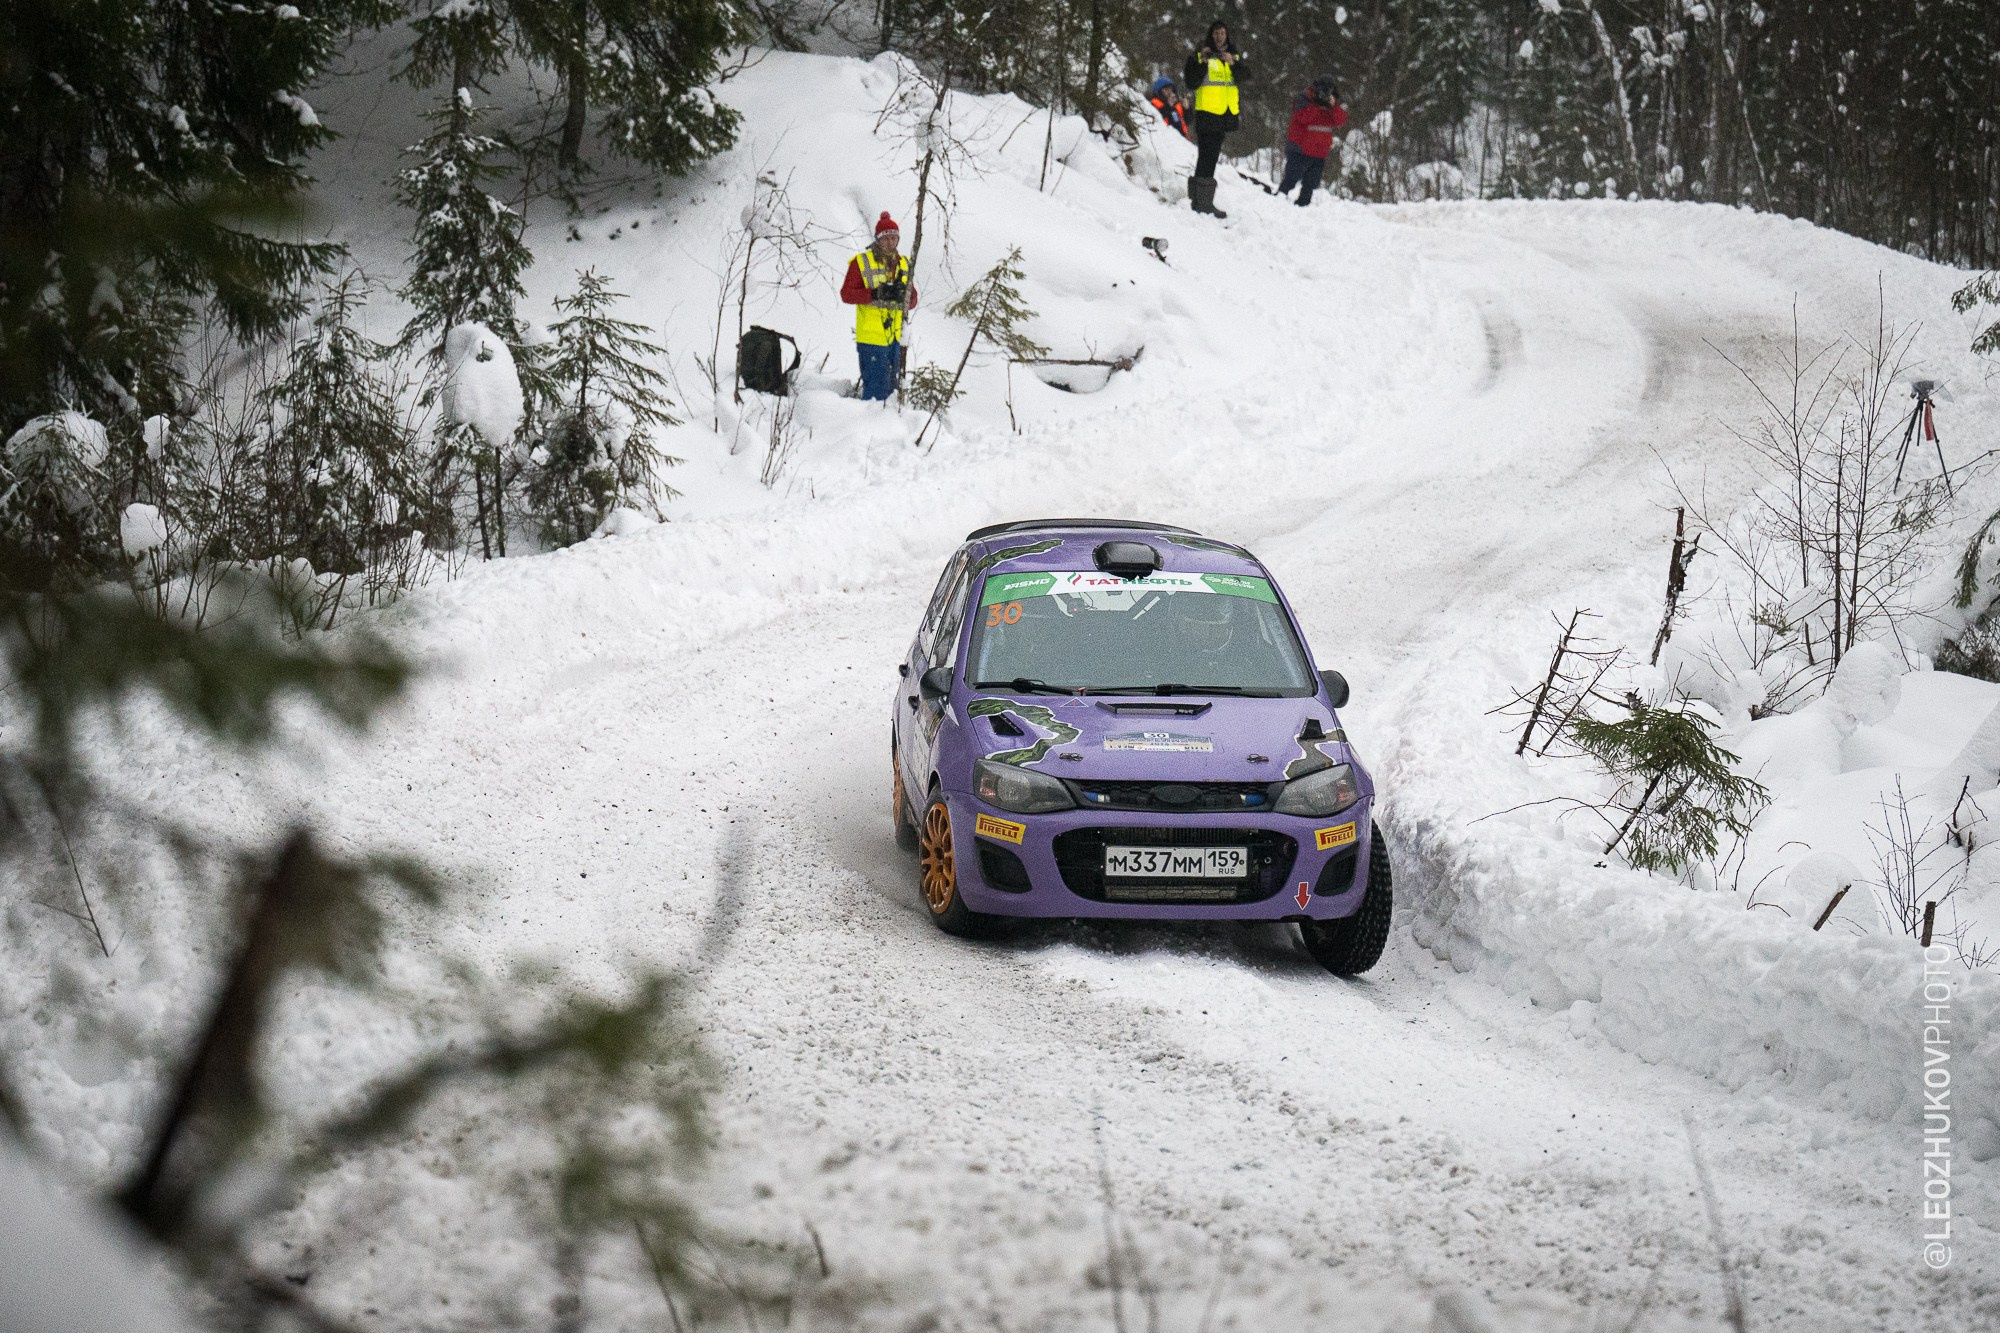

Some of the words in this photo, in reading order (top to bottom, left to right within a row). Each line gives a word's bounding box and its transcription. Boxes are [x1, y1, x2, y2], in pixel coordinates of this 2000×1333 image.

[986, 602, 1022, 627] 30
[979, 817, 1020, 839] PIRELLI
[1319, 825, 1354, 846] PIRELLI
[1113, 851, 1202, 873] М337ММ
[1207, 851, 1240, 867] 159
[1218, 867, 1236, 875] RUS
